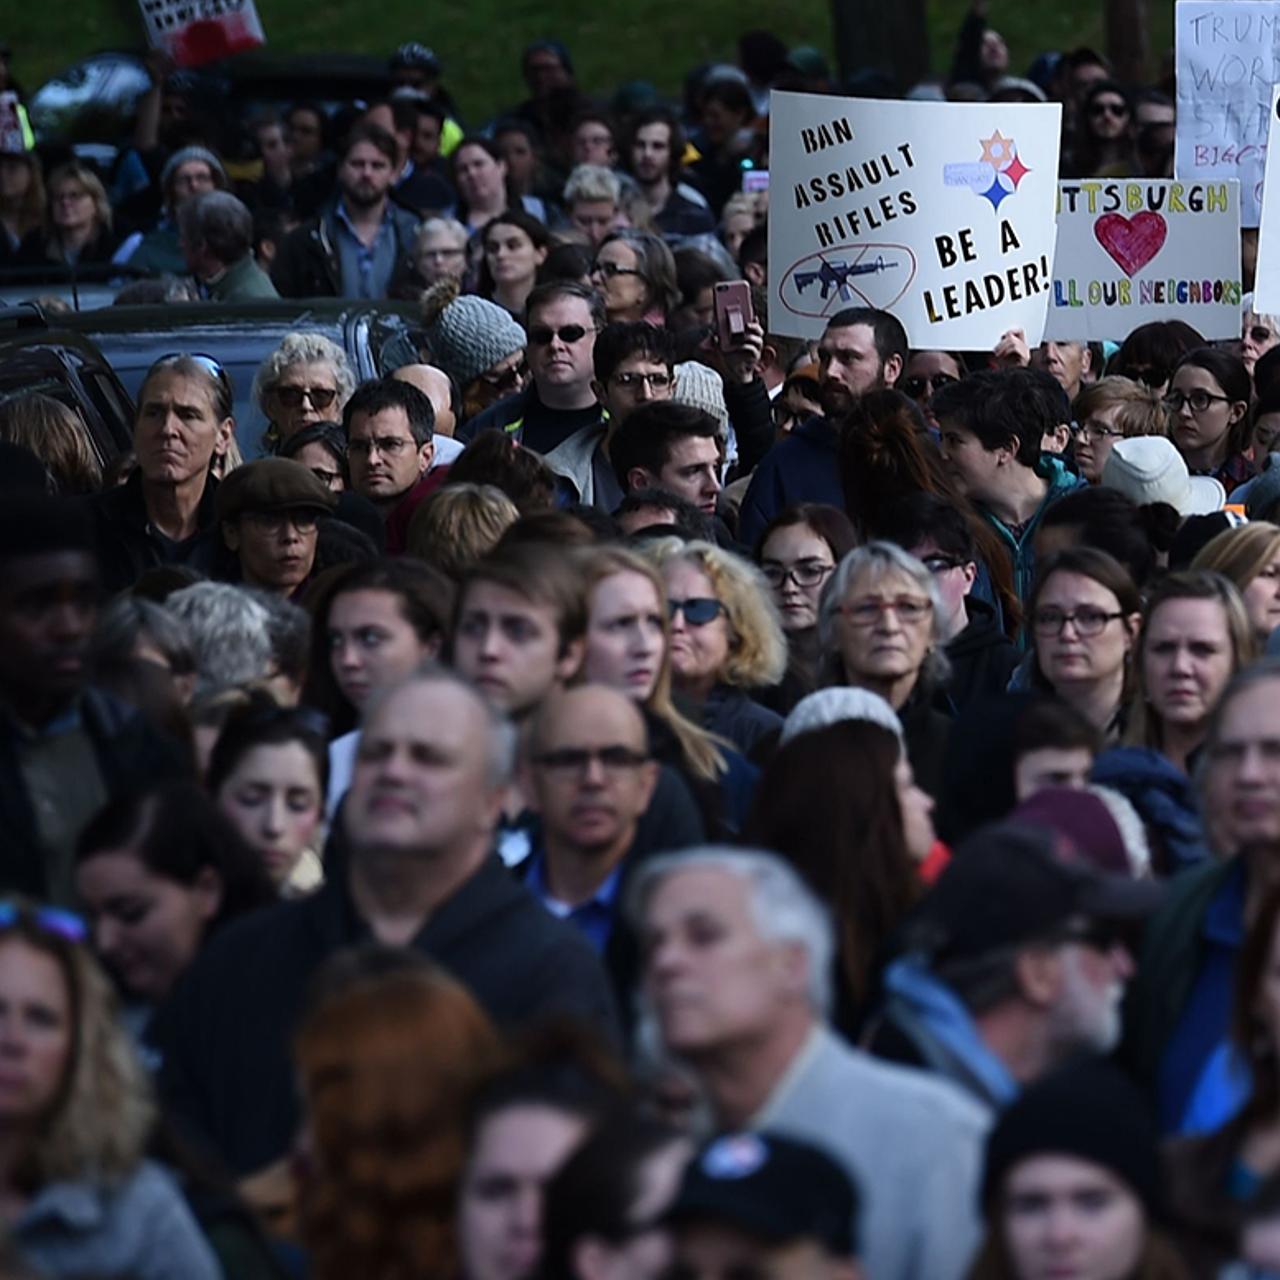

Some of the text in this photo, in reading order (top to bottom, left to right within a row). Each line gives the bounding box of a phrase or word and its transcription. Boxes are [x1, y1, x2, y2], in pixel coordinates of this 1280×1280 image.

[801, 117, 854, 155] BAN
[794, 142, 915, 210] ASSAULT
[815, 191, 918, 248] RIFLES
[935, 219, 1021, 269] BE A
[923, 255, 1051, 324] LEADER!
[1088, 278, 1133, 306] OUR
[1139, 278, 1242, 306] NEIGHBORS
